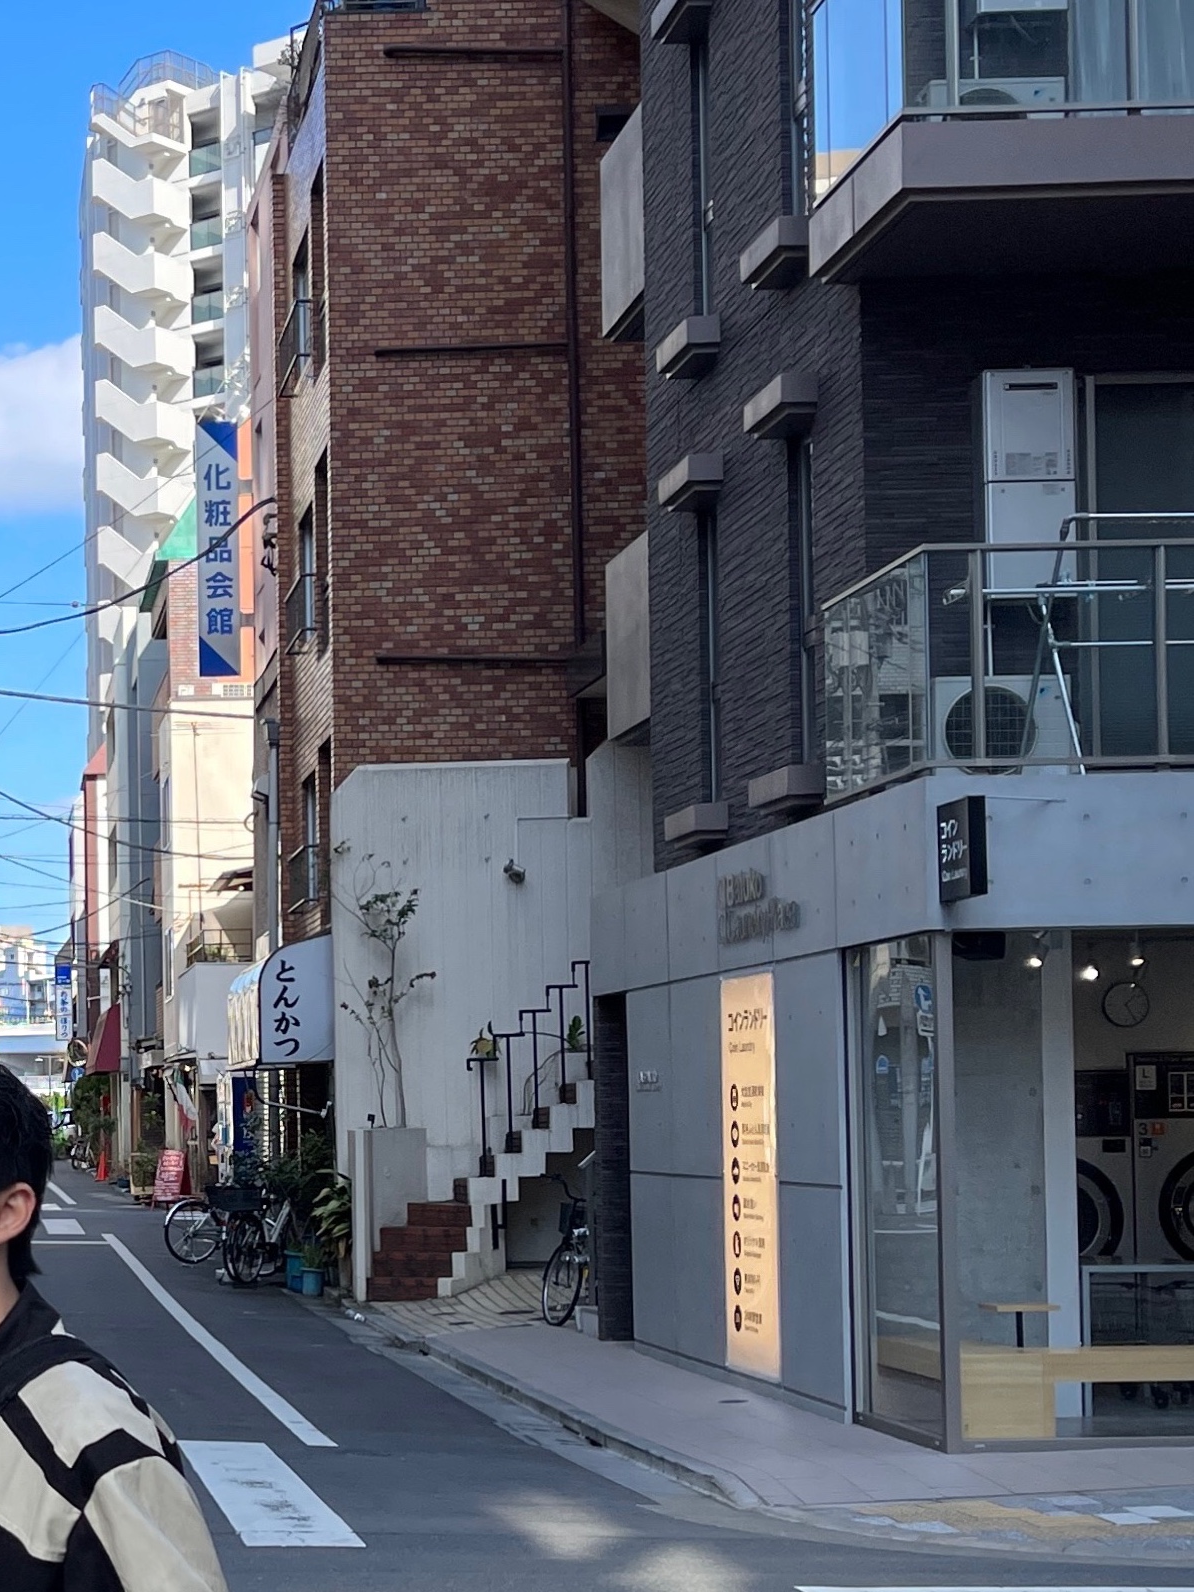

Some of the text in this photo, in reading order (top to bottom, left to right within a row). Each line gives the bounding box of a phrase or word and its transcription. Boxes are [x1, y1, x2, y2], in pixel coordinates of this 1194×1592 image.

[203, 463, 233, 635] 化粧品会館
[940, 819, 959, 839] コイン
[941, 839, 968, 863] ランドリー
[273, 959, 301, 1057] とんかつ
[728, 1007, 768, 1032] コインランドリー
[1138, 1123, 1148, 1135] 3
